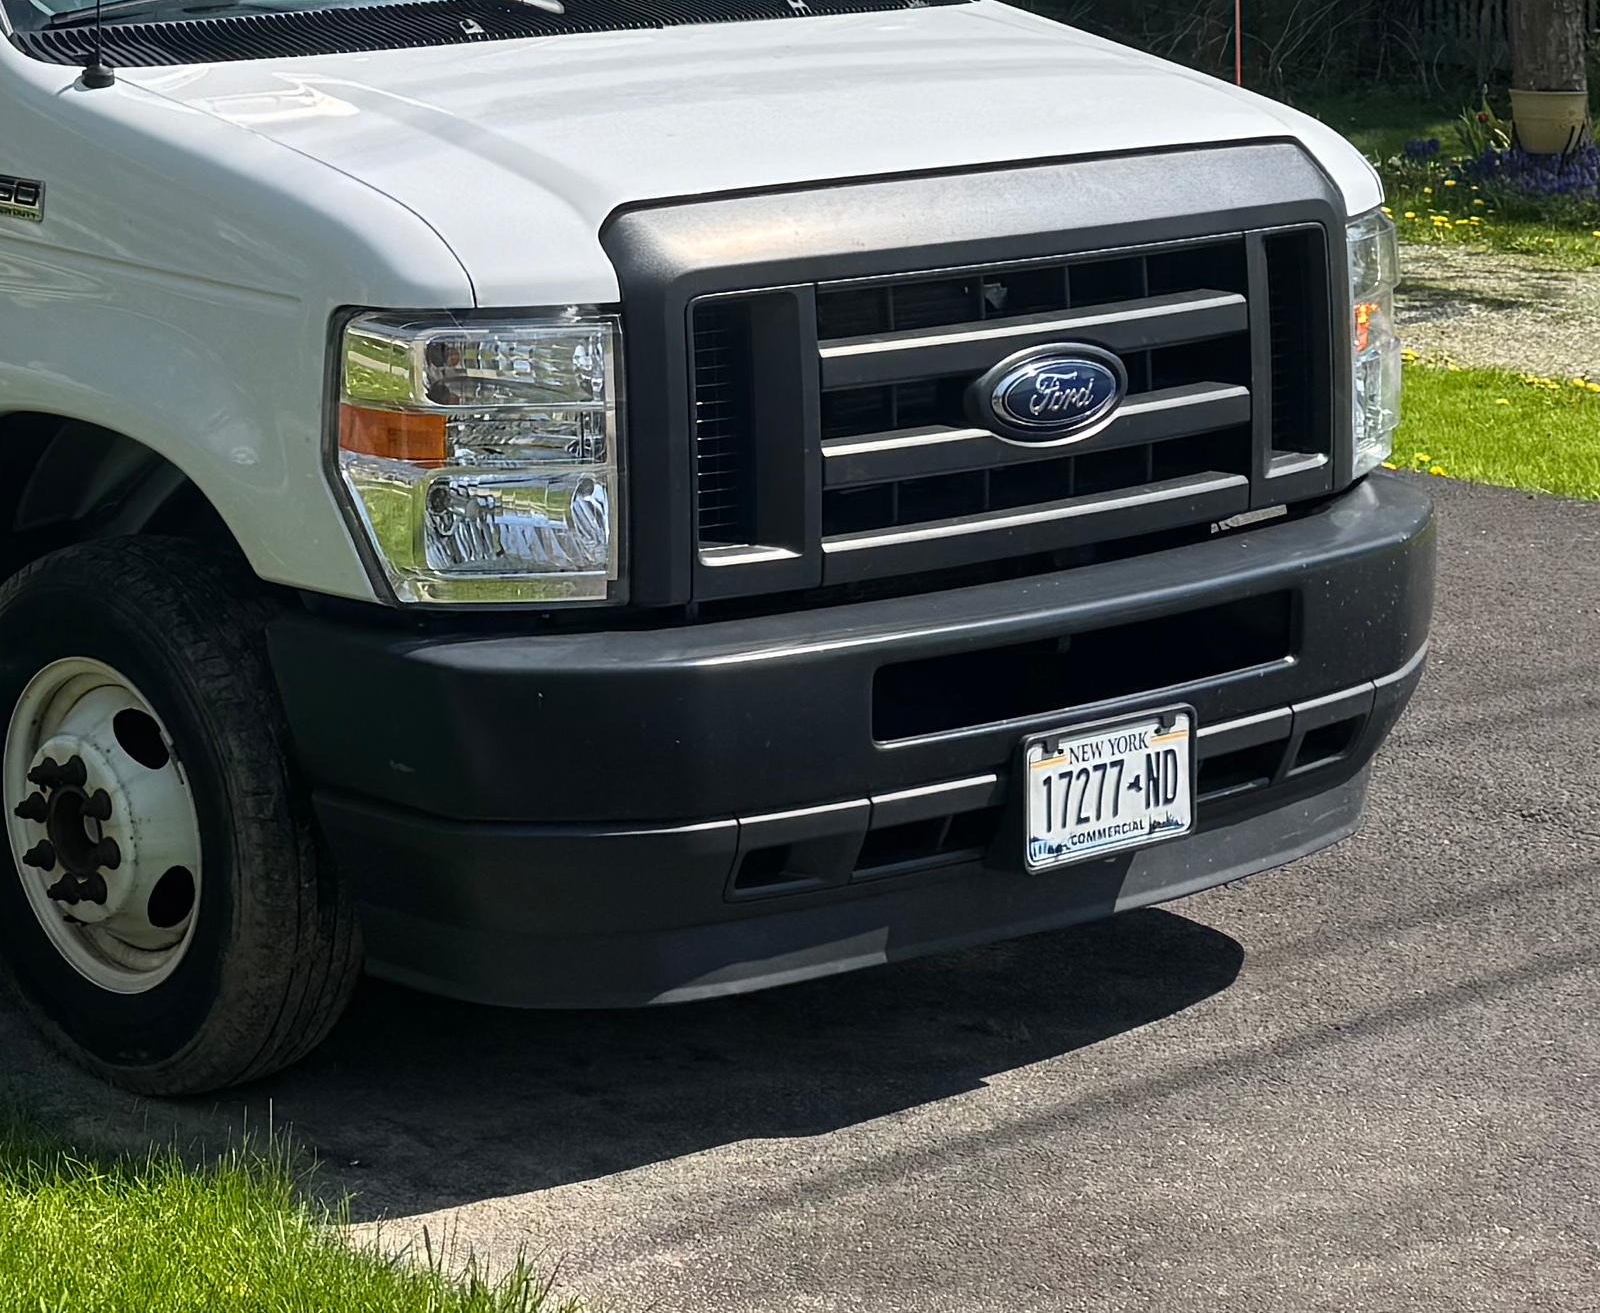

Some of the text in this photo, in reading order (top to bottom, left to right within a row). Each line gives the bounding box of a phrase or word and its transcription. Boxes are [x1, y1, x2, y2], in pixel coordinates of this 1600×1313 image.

[1029, 371, 1095, 416] Ford
[1069, 731, 1149, 764] NEW YORK
[1042, 748, 1179, 833] 17277 ND
[1070, 819, 1146, 845] COMMERCIAL
